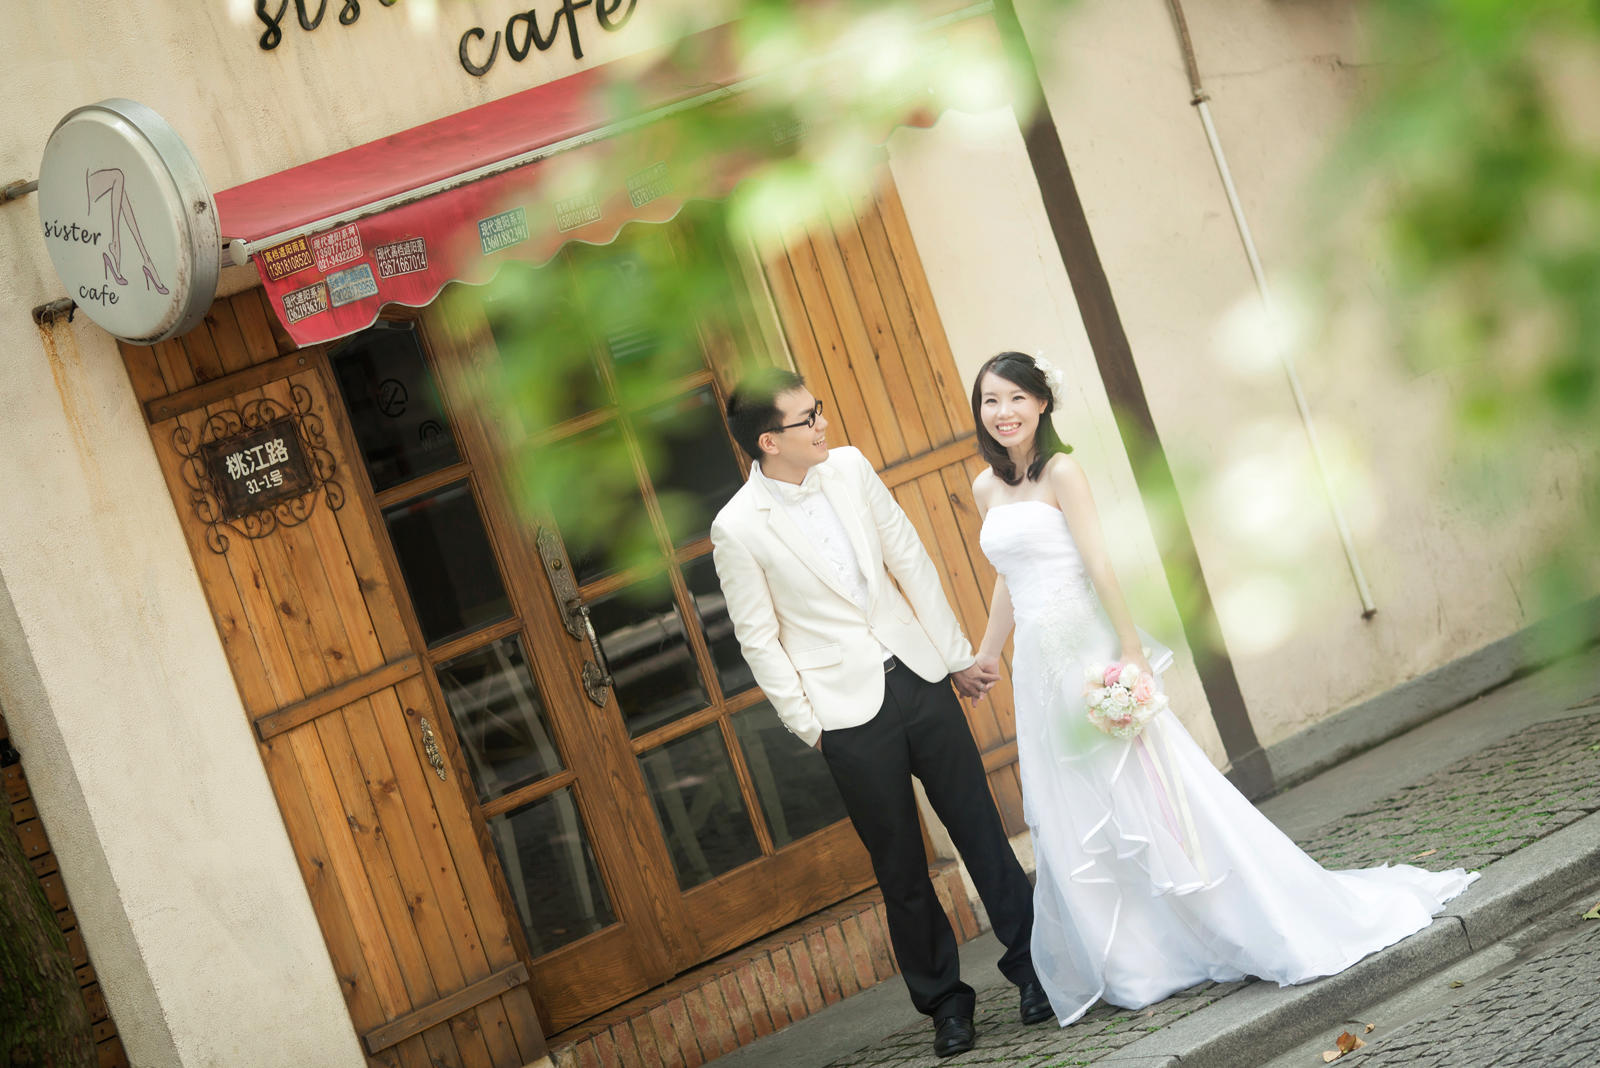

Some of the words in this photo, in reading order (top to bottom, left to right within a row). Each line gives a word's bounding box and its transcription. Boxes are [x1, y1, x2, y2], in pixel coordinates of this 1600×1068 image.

[459, 0, 637, 76] cafe
[44, 219, 102, 246] sister
[316, 235, 359, 260] 13501715708
[269, 250, 312, 276] 13818108520
[380, 252, 426, 276] 13671667014
[79, 284, 119, 306] cafe
[225, 438, 289, 481] 桃江路
[246, 469, 283, 494] 31-1号
